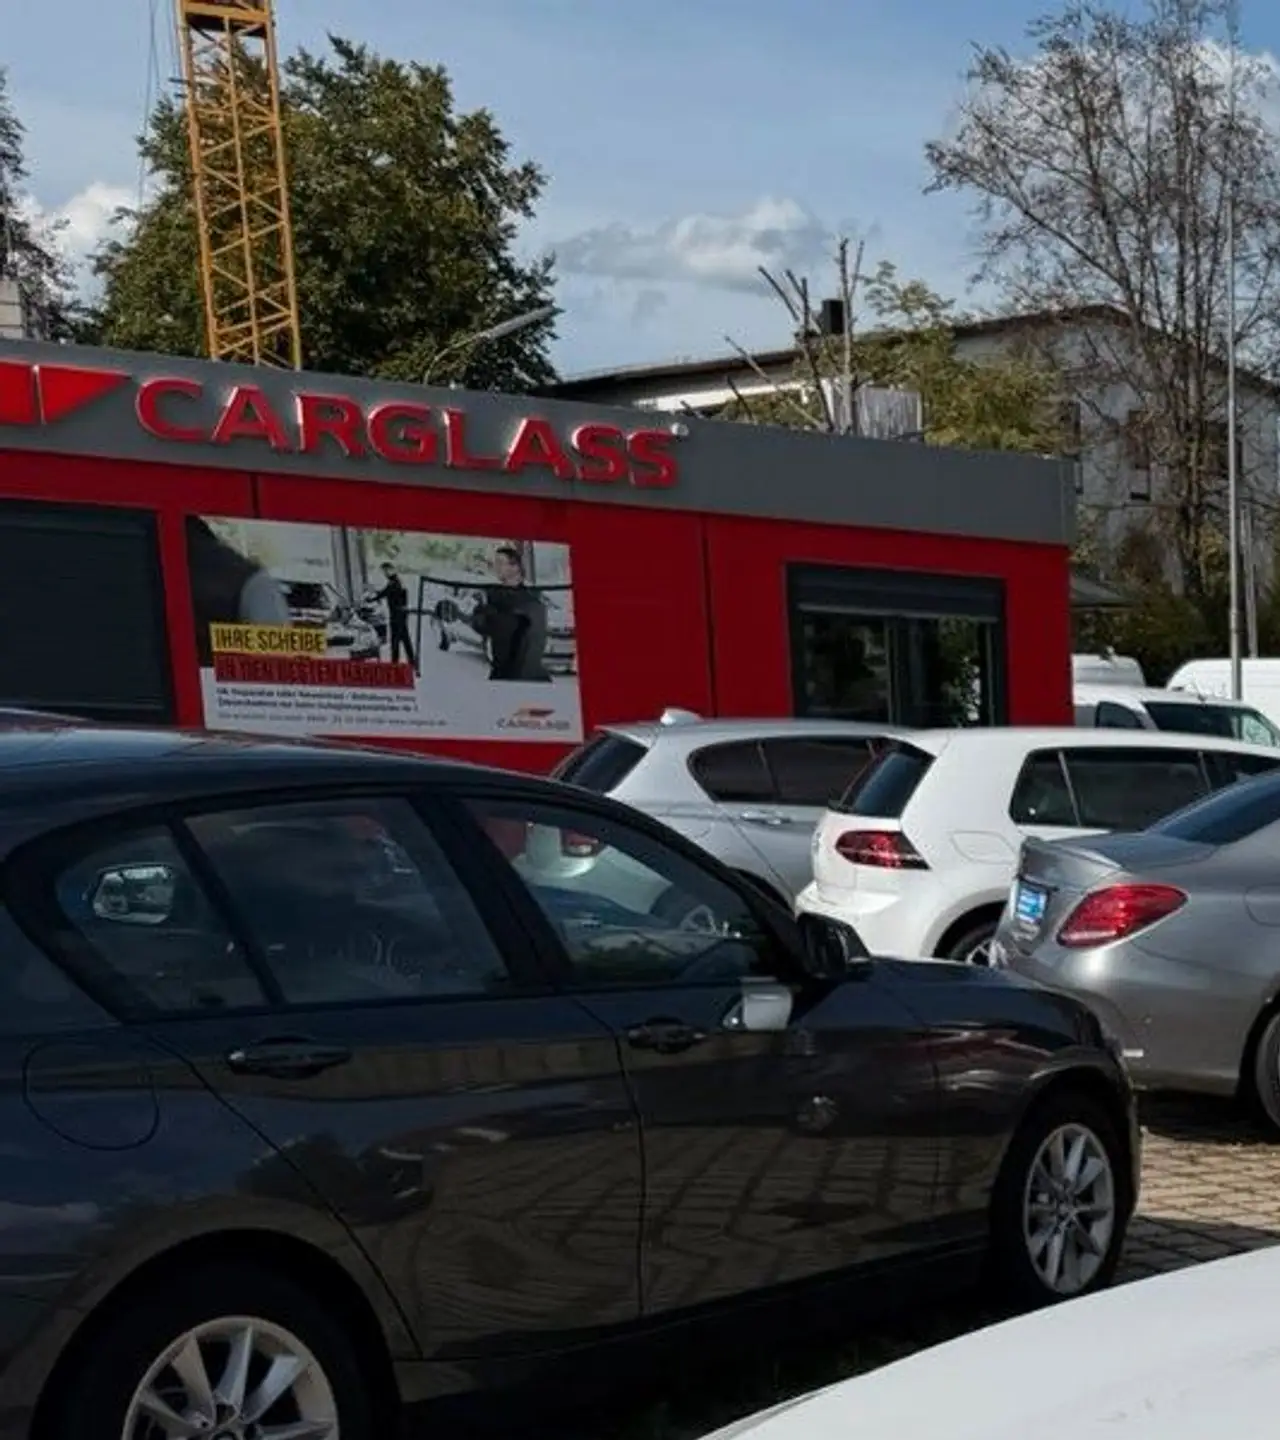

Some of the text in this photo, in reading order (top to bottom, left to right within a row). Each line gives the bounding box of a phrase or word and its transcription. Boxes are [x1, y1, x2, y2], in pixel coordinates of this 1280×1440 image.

[136, 377, 682, 488] CARGLASS
[215, 628, 325, 653] IHRE SCHEIBE
